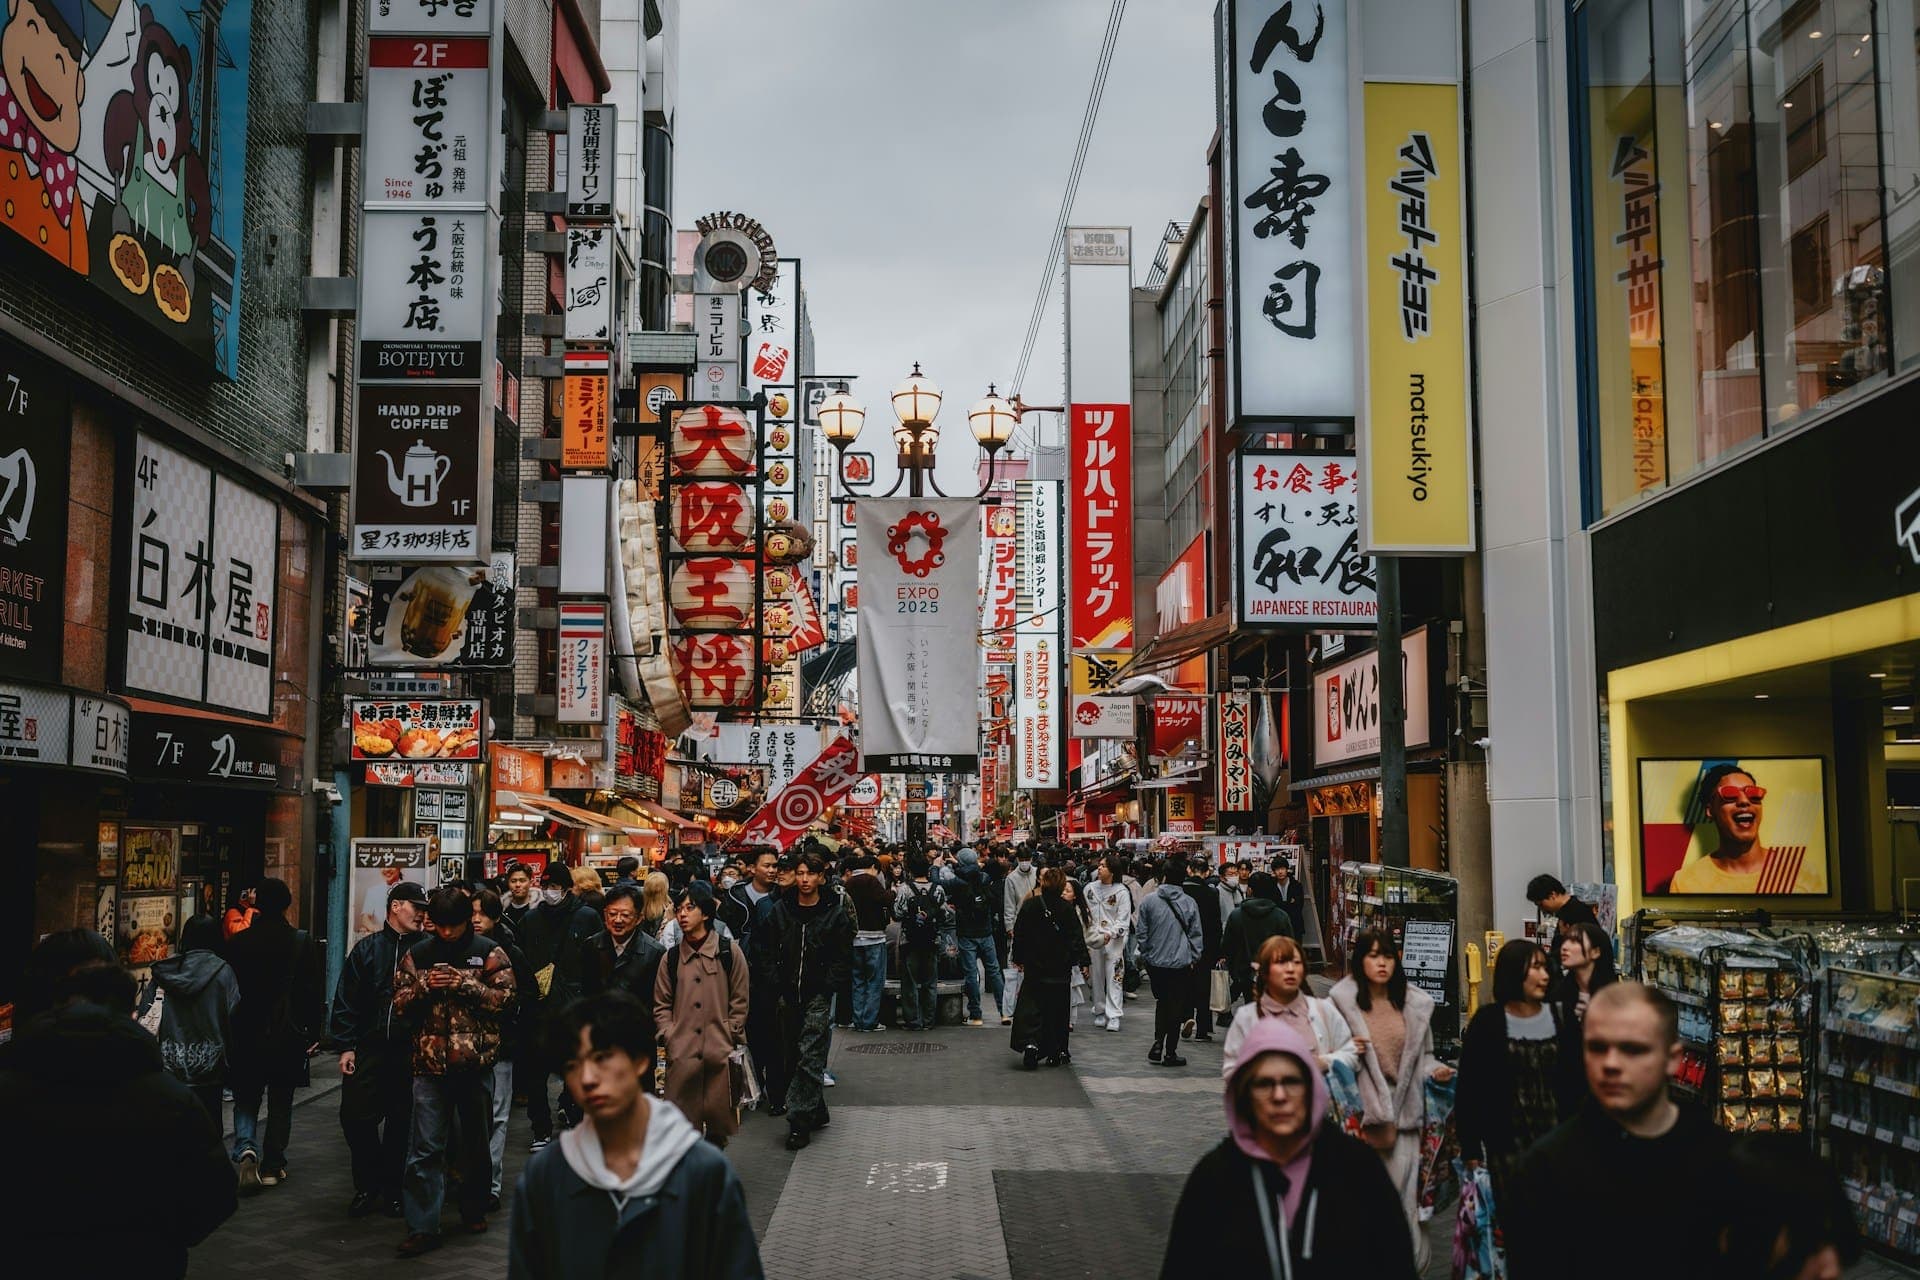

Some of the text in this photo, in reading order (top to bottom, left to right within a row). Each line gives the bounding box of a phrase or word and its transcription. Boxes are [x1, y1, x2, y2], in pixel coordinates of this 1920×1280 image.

[413, 43, 448, 66] 2F
[452, 135, 466, 193] 元祖 発祥
[384, 178, 413, 188] Since
[385, 190, 412, 199] 1946
[1391, 133, 1437, 339] マツモトキヨシ
[450, 219, 465, 299] 大阪伝統の味
[567, 276, 608, 312] Leaf
[378, 351, 465, 368] BOTEJYU
[7, 374, 29, 416] 7F
[378, 404, 462, 417] HAND DRIP
[390, 418, 449, 430] COFFEE
[578, 377, 593, 449] ミティラー
[1406, 373, 1432, 502] matsukiyo
[137, 454, 159, 491] 4F
[1253, 462, 1358, 496] お食事
[451, 500, 470, 515] 1F
[1084, 410, 1119, 618] ツルハドラッグ
[360, 528, 471, 551] 星乃珈琲店
[670, 404, 758, 706] 大阪王将
[136, 507, 254, 638] 白木屋
[489, 560, 508, 659] 台湾タピオカ
[897, 587, 939, 599] EXPO
[898, 601, 939, 613] 2025
[1249, 600, 1378, 616] JAPANESE RESTAURAN
[469, 610, 487, 659] 専門店
[577, 639, 588, 700] クンテープ
[1023, 651, 1033, 699] KARAOKE
[1037, 650, 1049, 700] カラオケ
[80, 702, 92, 717] 4F
[360, 704, 473, 721] 神戸牛と海鮮丼
[1109, 703, 1130, 711] Japan
[1115, 719, 1131, 727] Shop
[1156, 700, 1200, 714] ツルハ
[156, 732, 184, 765] 7F
[1023, 717, 1033, 779] MANEKINEKO
[1036, 715, 1050, 784] まねきねこ
[1223, 699, 1247, 804] 大阪みやげ
[1170, 796, 1186, 817] 薬
[358, 852, 421, 867] マッサージ
